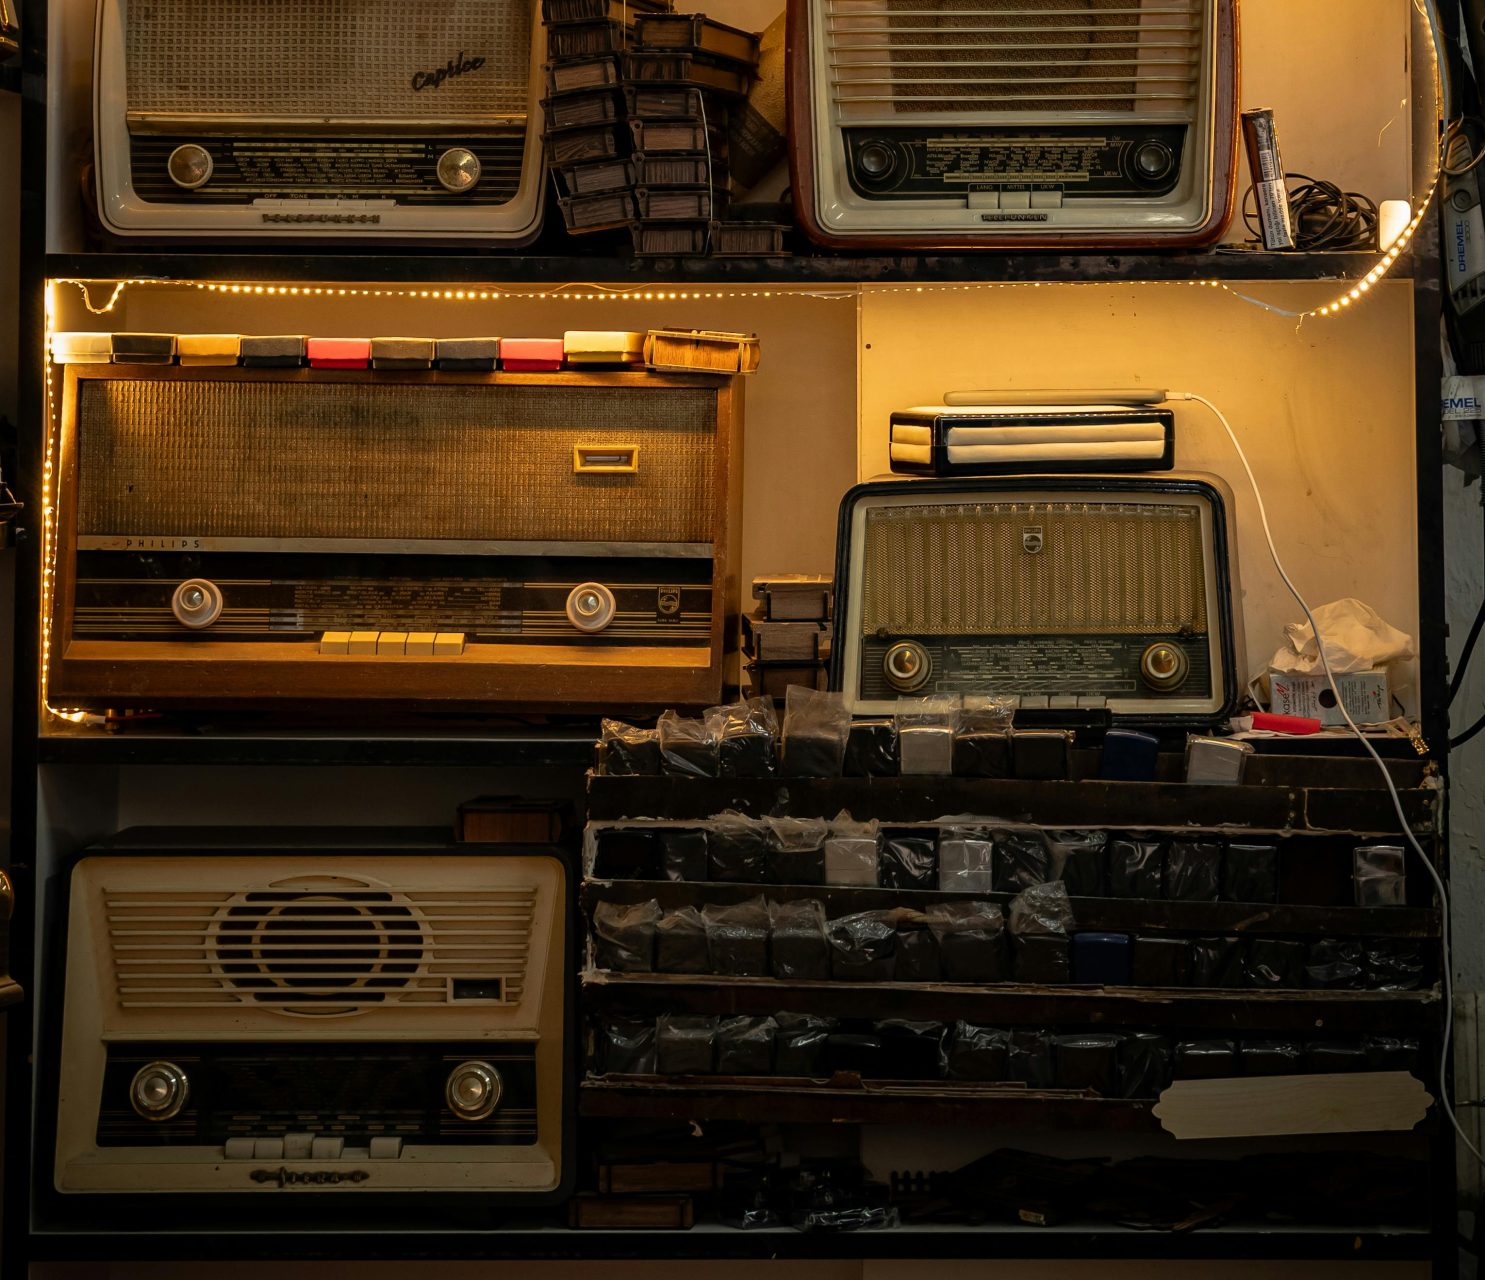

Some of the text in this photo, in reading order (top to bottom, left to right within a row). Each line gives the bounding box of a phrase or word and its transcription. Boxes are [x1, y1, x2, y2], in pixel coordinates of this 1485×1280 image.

[412, 51, 486, 91] Caprice
[262, 213, 380, 224] TELEFUNKEN
[982, 214, 1048, 222] TELEFUNKEN
[1455, 220, 1466, 272] DREMEL
[127, 540, 199, 549] PHILIPS
